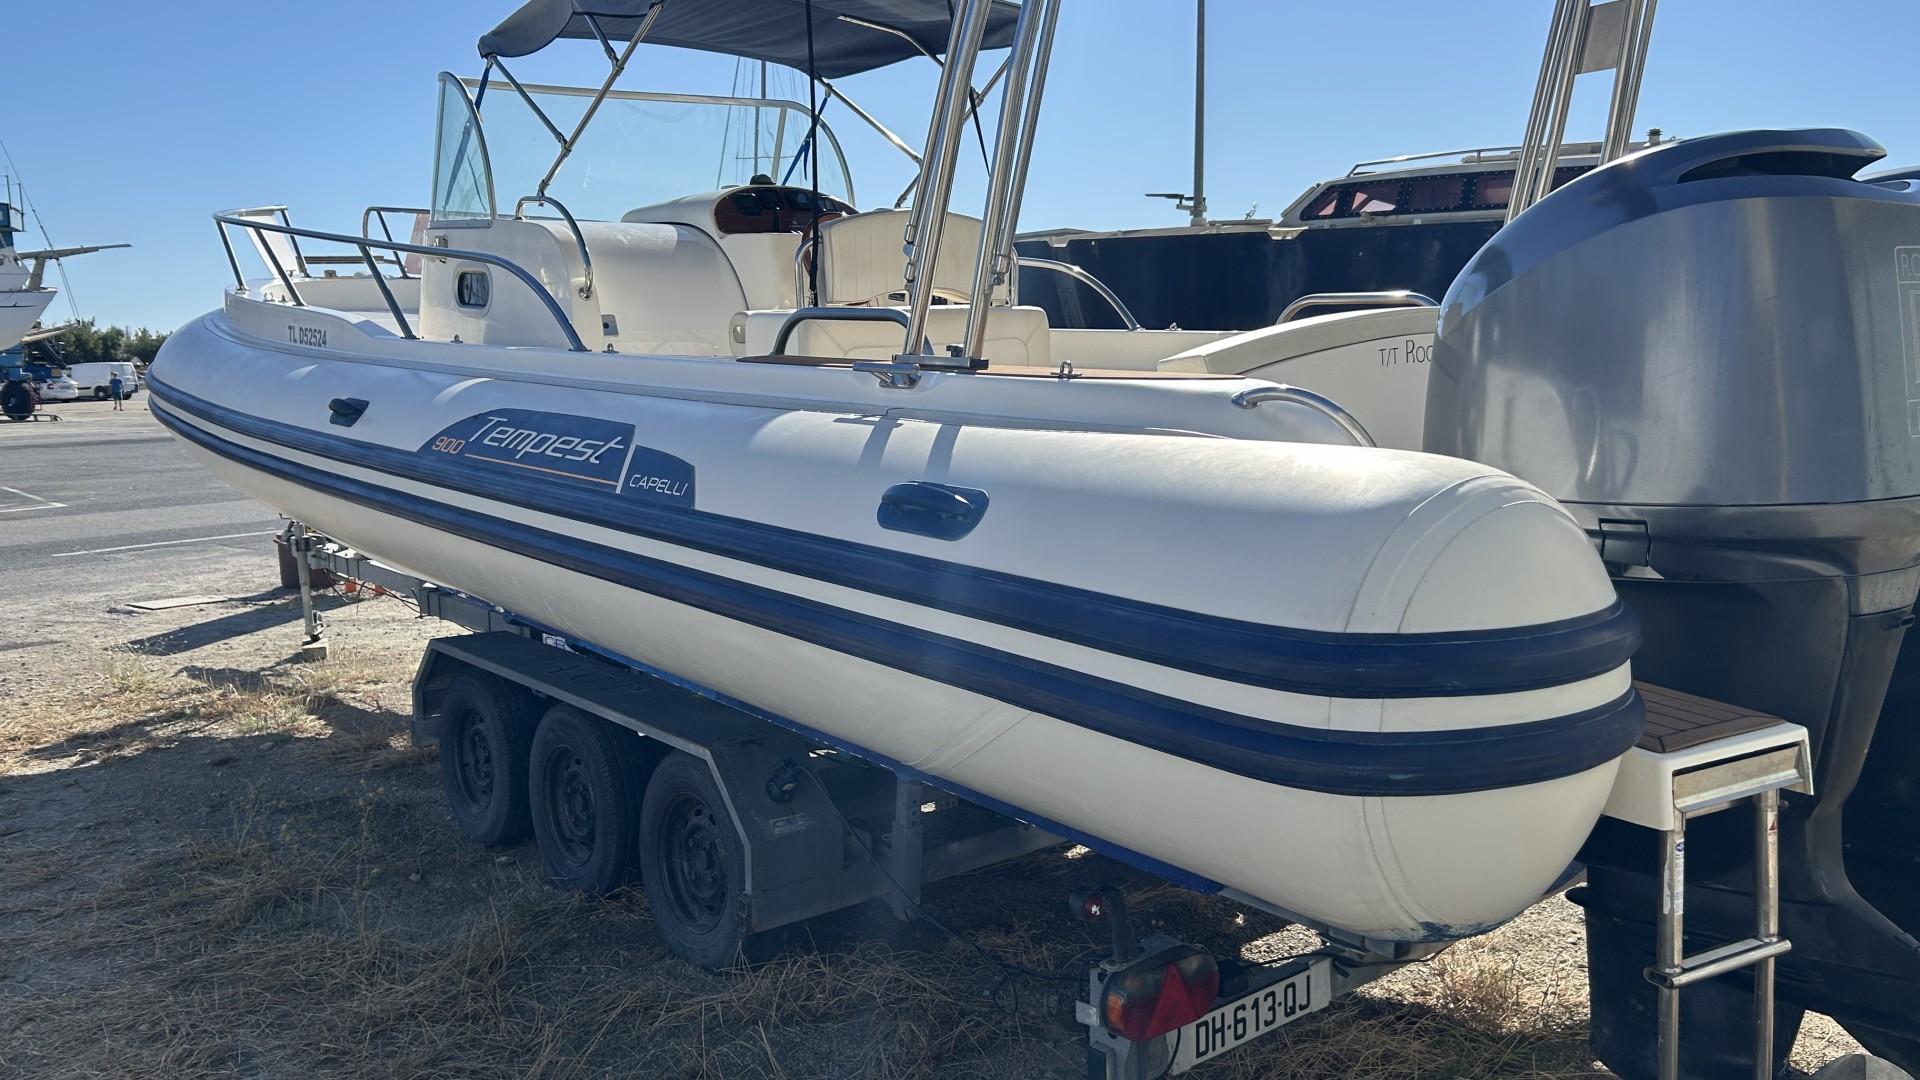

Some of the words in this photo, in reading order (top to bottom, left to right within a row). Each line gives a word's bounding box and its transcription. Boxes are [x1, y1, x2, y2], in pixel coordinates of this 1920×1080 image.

[288, 325, 298, 344] TL
[299, 326, 327, 349] D52524
[1378, 347, 1399, 367] T/T
[432, 436, 466, 455] 900
[469, 416, 624, 464] Tempest
[629, 474, 688, 496] CAPELLI
[1195, 974, 1311, 1059] DH-613-QJ
